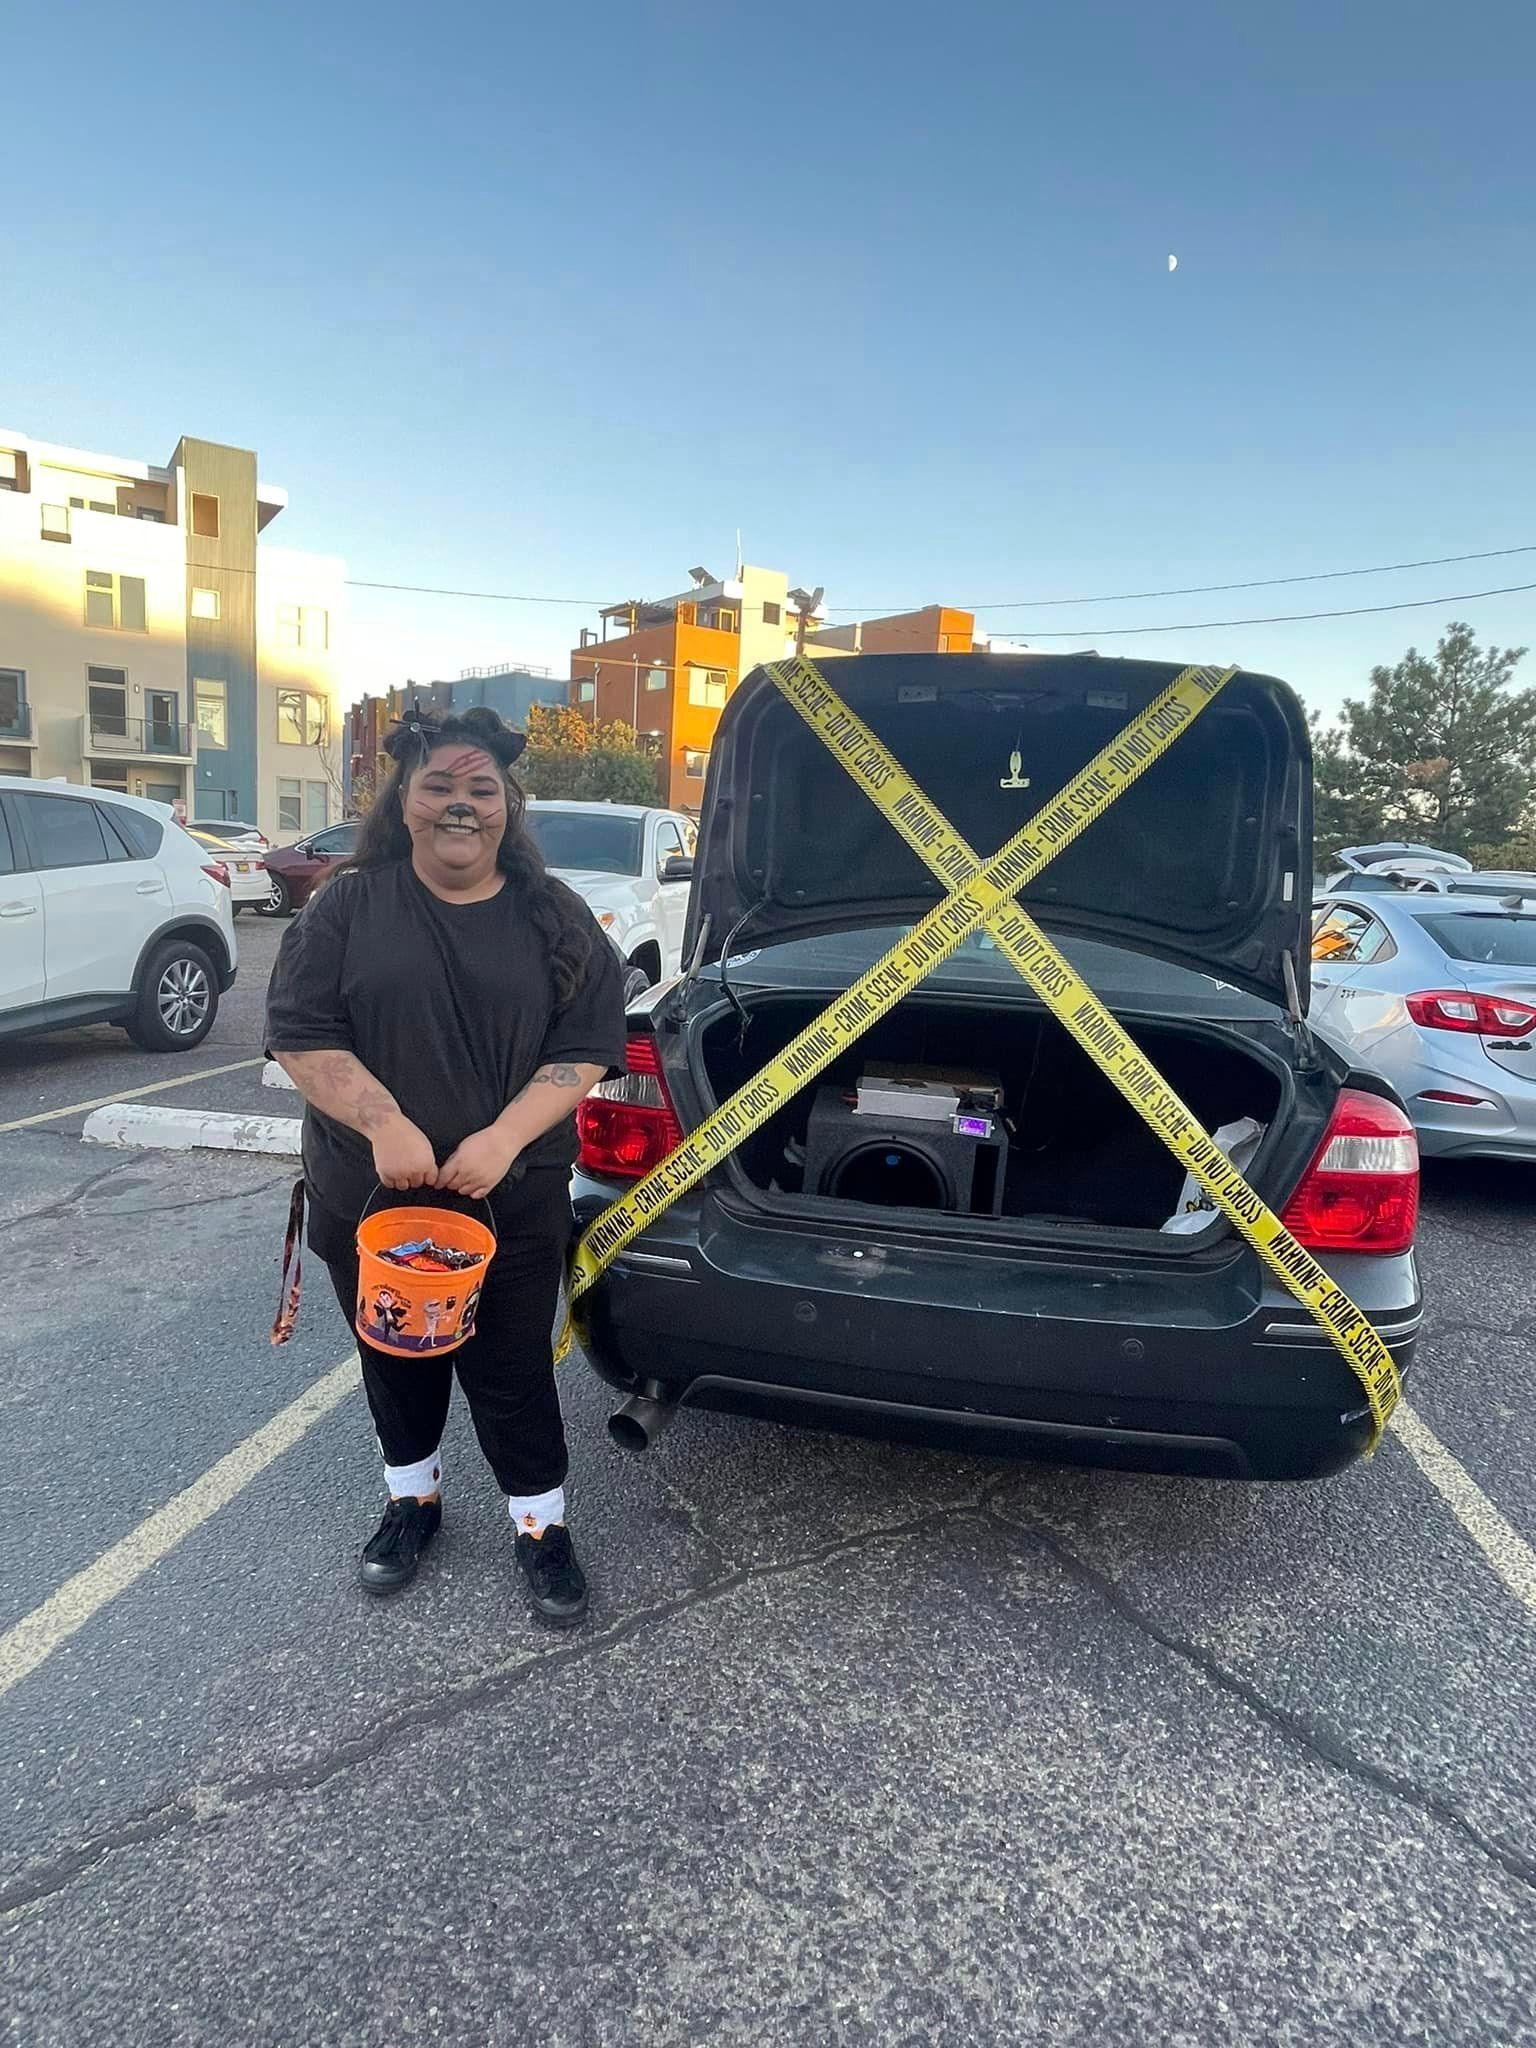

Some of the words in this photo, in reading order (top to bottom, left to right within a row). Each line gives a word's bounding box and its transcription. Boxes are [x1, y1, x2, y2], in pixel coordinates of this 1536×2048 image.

[793, 674, 834, 717] SCENE
[824, 711, 845, 737] DO
[836, 722, 869, 754] NOT
[853, 748, 896, 790] CROSS
[1145, 695, 1192, 740] CROSS
[1108, 749, 1137, 775] DO
[1122, 727, 1157, 764] NOT
[1069, 769, 1117, 812] SCENE
[891, 791, 945, 848] WARNING
[1036, 801, 1083, 844] CRIME
[984, 838, 1042, 892] WARNING
[997, 916, 1025, 941] DO
[1015, 930, 1045, 962] NOT
[782, 1026, 838, 1079] WARNING
[834, 991, 877, 1033] CRIME
[865, 961, 910, 1004] SCENE
[903, 941, 930, 969] DO
[917, 922, 949, 955] NOT
[940, 892, 984, 935] CROSS
[1029, 956, 1073, 997] CROSS
[1071, 1001, 1126, 1061] WARNING
[1119, 1058, 1163, 1104] CRIME
[1149, 1093, 1194, 1140] SCENE
[1186, 1137, 1214, 1163] DO
[1201, 1153, 1237, 1186] NOT
[1222, 1178, 1268, 1224] CROSS
[586, 1206, 635, 1260] WARNING
[634, 1174, 673, 1215] CRIME
[668, 1143, 708, 1185] SCENE
[705, 1127, 724, 1153] DO
[718, 1107, 747, 1142] NOT
[742, 1077, 780, 1120] CROSS
[1267, 1229, 1326, 1290] WARNING
[1319, 1290, 1364, 1339] CRIME
[1348, 1327, 1386, 1376] SCENE
